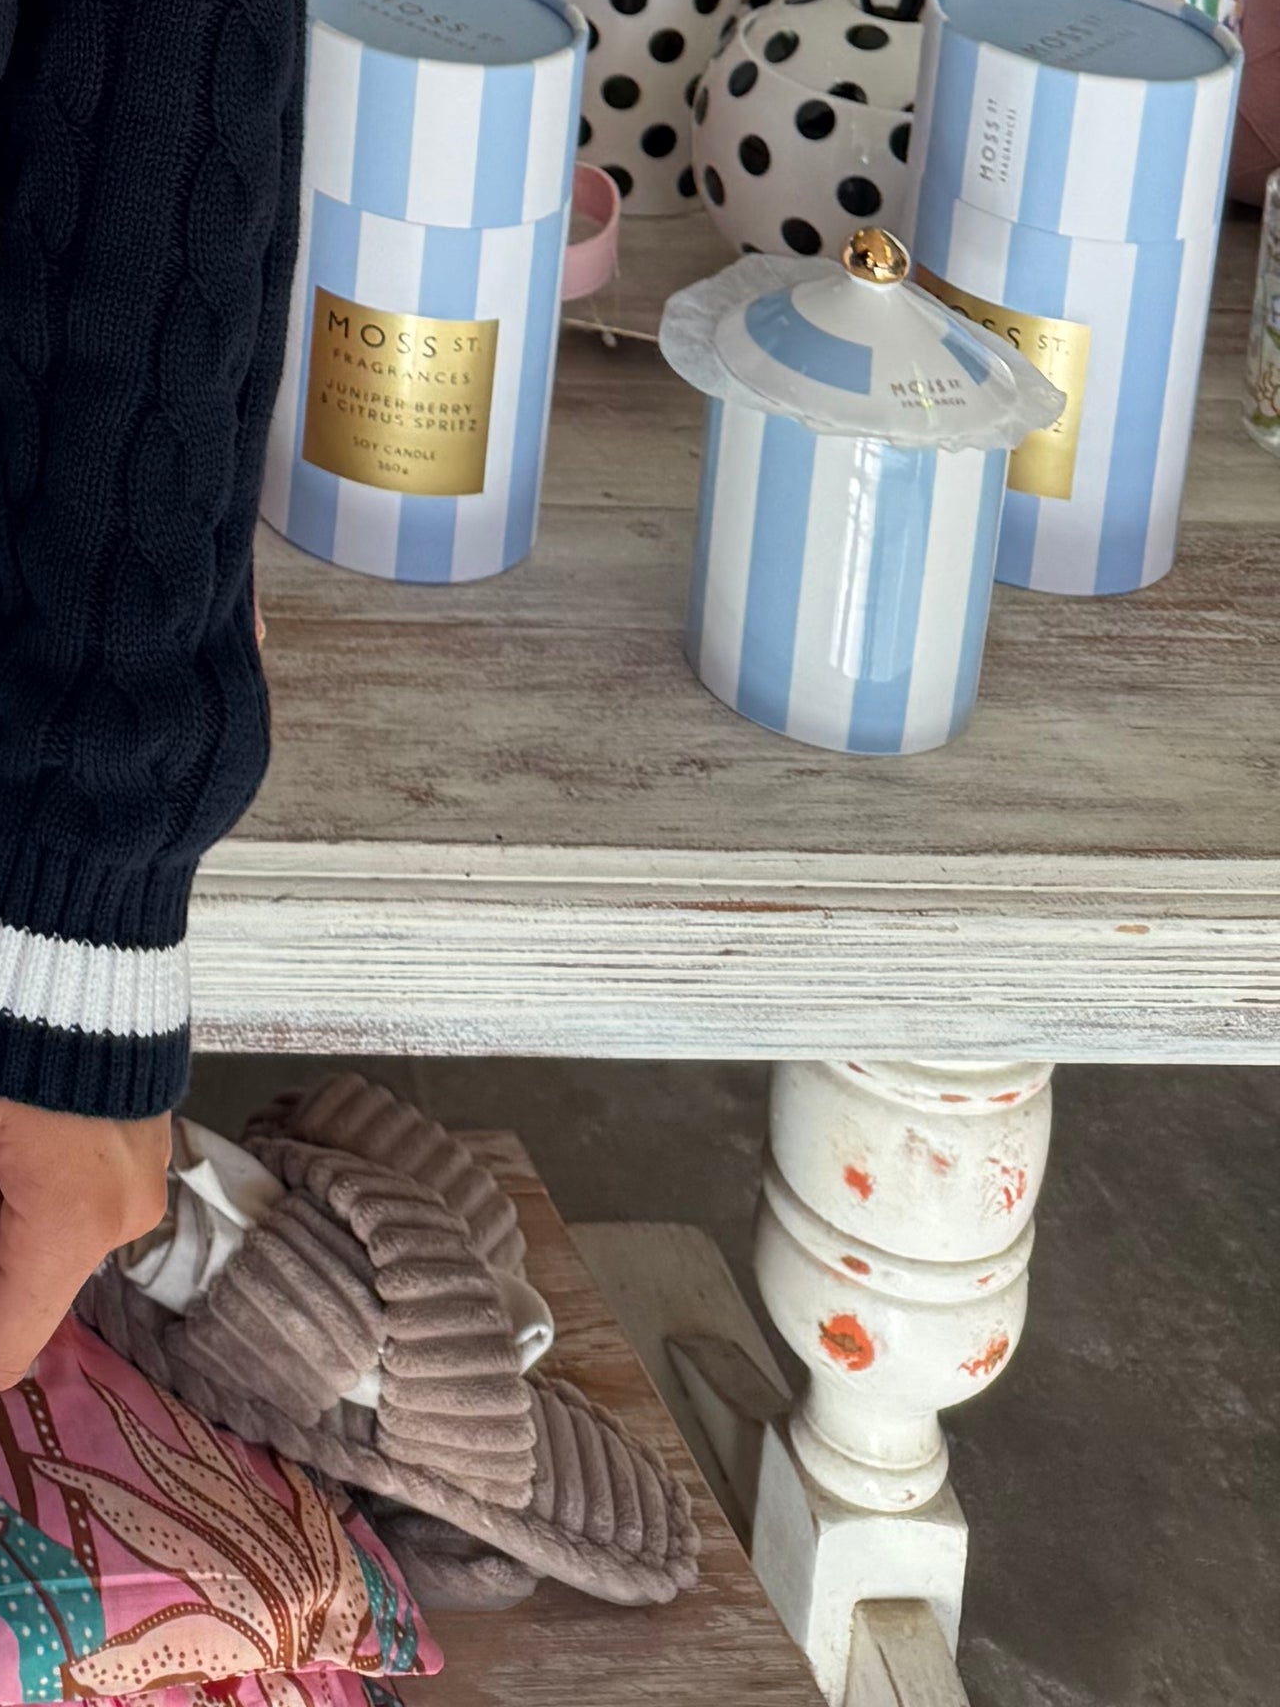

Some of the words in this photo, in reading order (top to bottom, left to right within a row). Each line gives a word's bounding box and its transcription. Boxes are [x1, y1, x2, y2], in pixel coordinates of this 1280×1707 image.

[978, 119, 1000, 182] MOSS
[328, 310, 438, 359] MOSS
[453, 337, 482, 353] ST.
[1038, 334, 1070, 355] ST.
[332, 348, 472, 385] FRAGRANCES
[325, 378, 405, 410] JUNIPER
[414, 401, 473, 416] BERRY
[890, 378, 946, 396] MOSS
[337, 398, 405, 427] CITRUS
[413, 416, 479, 433] SPRITZ
[352, 435, 378, 451] SOY
[383, 444, 437, 462] CANDLE
